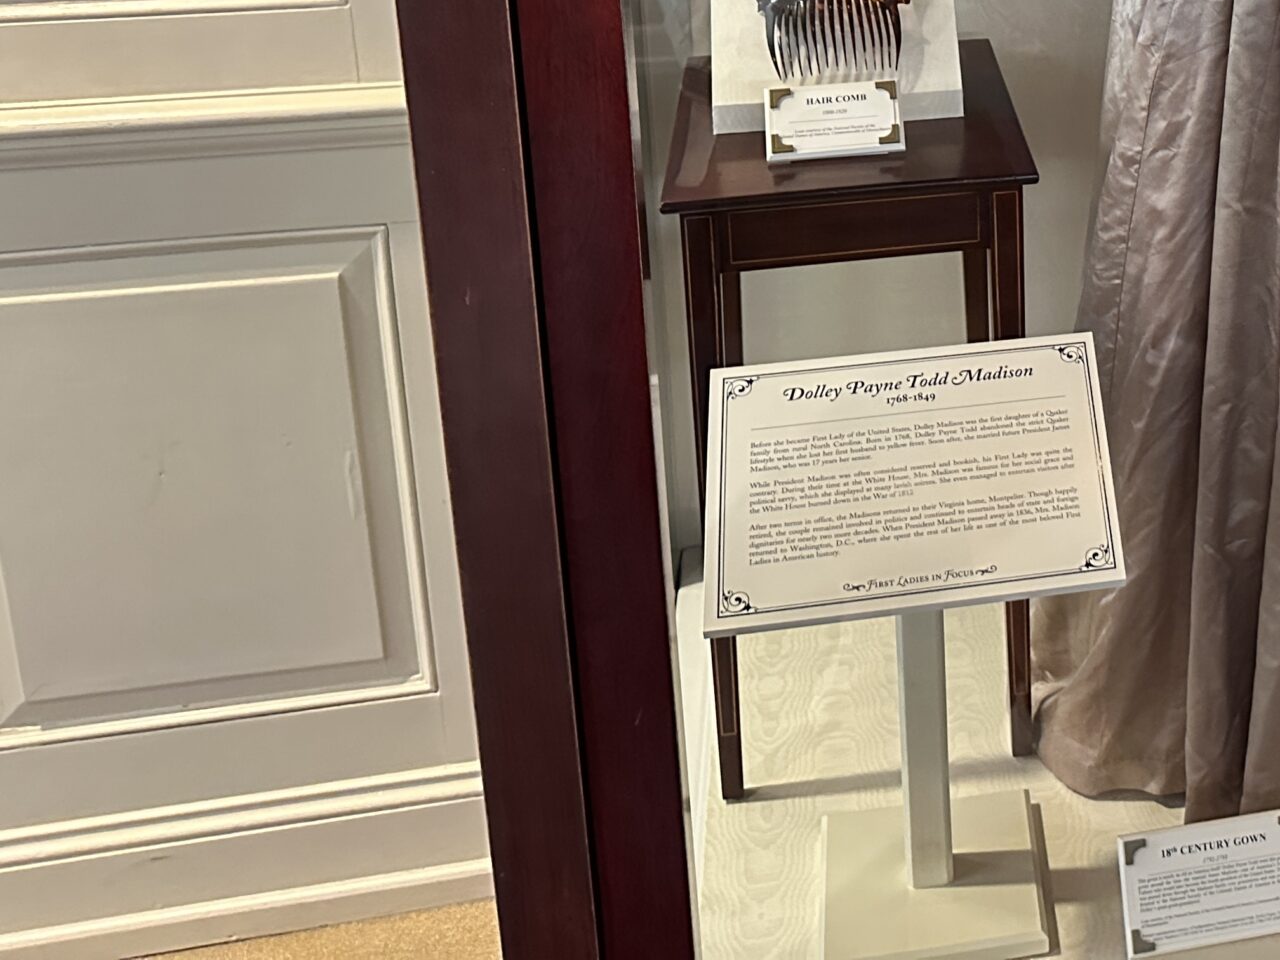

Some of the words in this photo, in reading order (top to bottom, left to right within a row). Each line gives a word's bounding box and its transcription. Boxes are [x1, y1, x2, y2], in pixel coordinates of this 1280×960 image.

[806, 96, 833, 106] HAIR
[835, 93, 867, 104] COMB
[783, 384, 842, 402] Dolley
[846, 380, 902, 398] Payne
[906, 371, 949, 388] Todd
[951, 365, 1033, 386] Madison
[886, 392, 936, 407] 1768-1849
[829, 432, 844, 441] Lady
[913, 423, 934, 431] Dolley
[1045, 408, 1068, 417] Quaker
[914, 431, 936, 439] Dolley
[938, 428, 957, 437] Payne
[1045, 416, 1069, 425] Quaker
[1021, 426, 1050, 434] President
[1051, 424, 1070, 432] James
[750, 480, 770, 488] While
[773, 476, 804, 485] President
[807, 473, 836, 481] Madison
[1011, 451, 1028, 460] Lady
[781, 485, 805, 494] During
[930, 467, 959, 476] Madison
[762, 504, 783, 512] White
[785, 501, 806, 509] House
[848, 510, 880, 519] Madisons
[939, 500, 965, 510] Virginia
[1028, 489, 1053, 499] Though
[882, 524, 903, 532] When
[904, 520, 935, 529] President
[936, 517, 965, 525] Madison
[1051, 503, 1080, 511] Madison
[749, 557, 771, 565] Ladies
[781, 552, 814, 561] American
[866, 579, 895, 592] FIRST
[897, 575, 929, 588] LADIES
[932, 573, 942, 582] IN
[943, 569, 974, 582] FOCUS
[1161, 846, 1178, 859] 18th
[1180, 838, 1230, 856] CENTURY
[1233, 832, 1267, 846] GOWN
